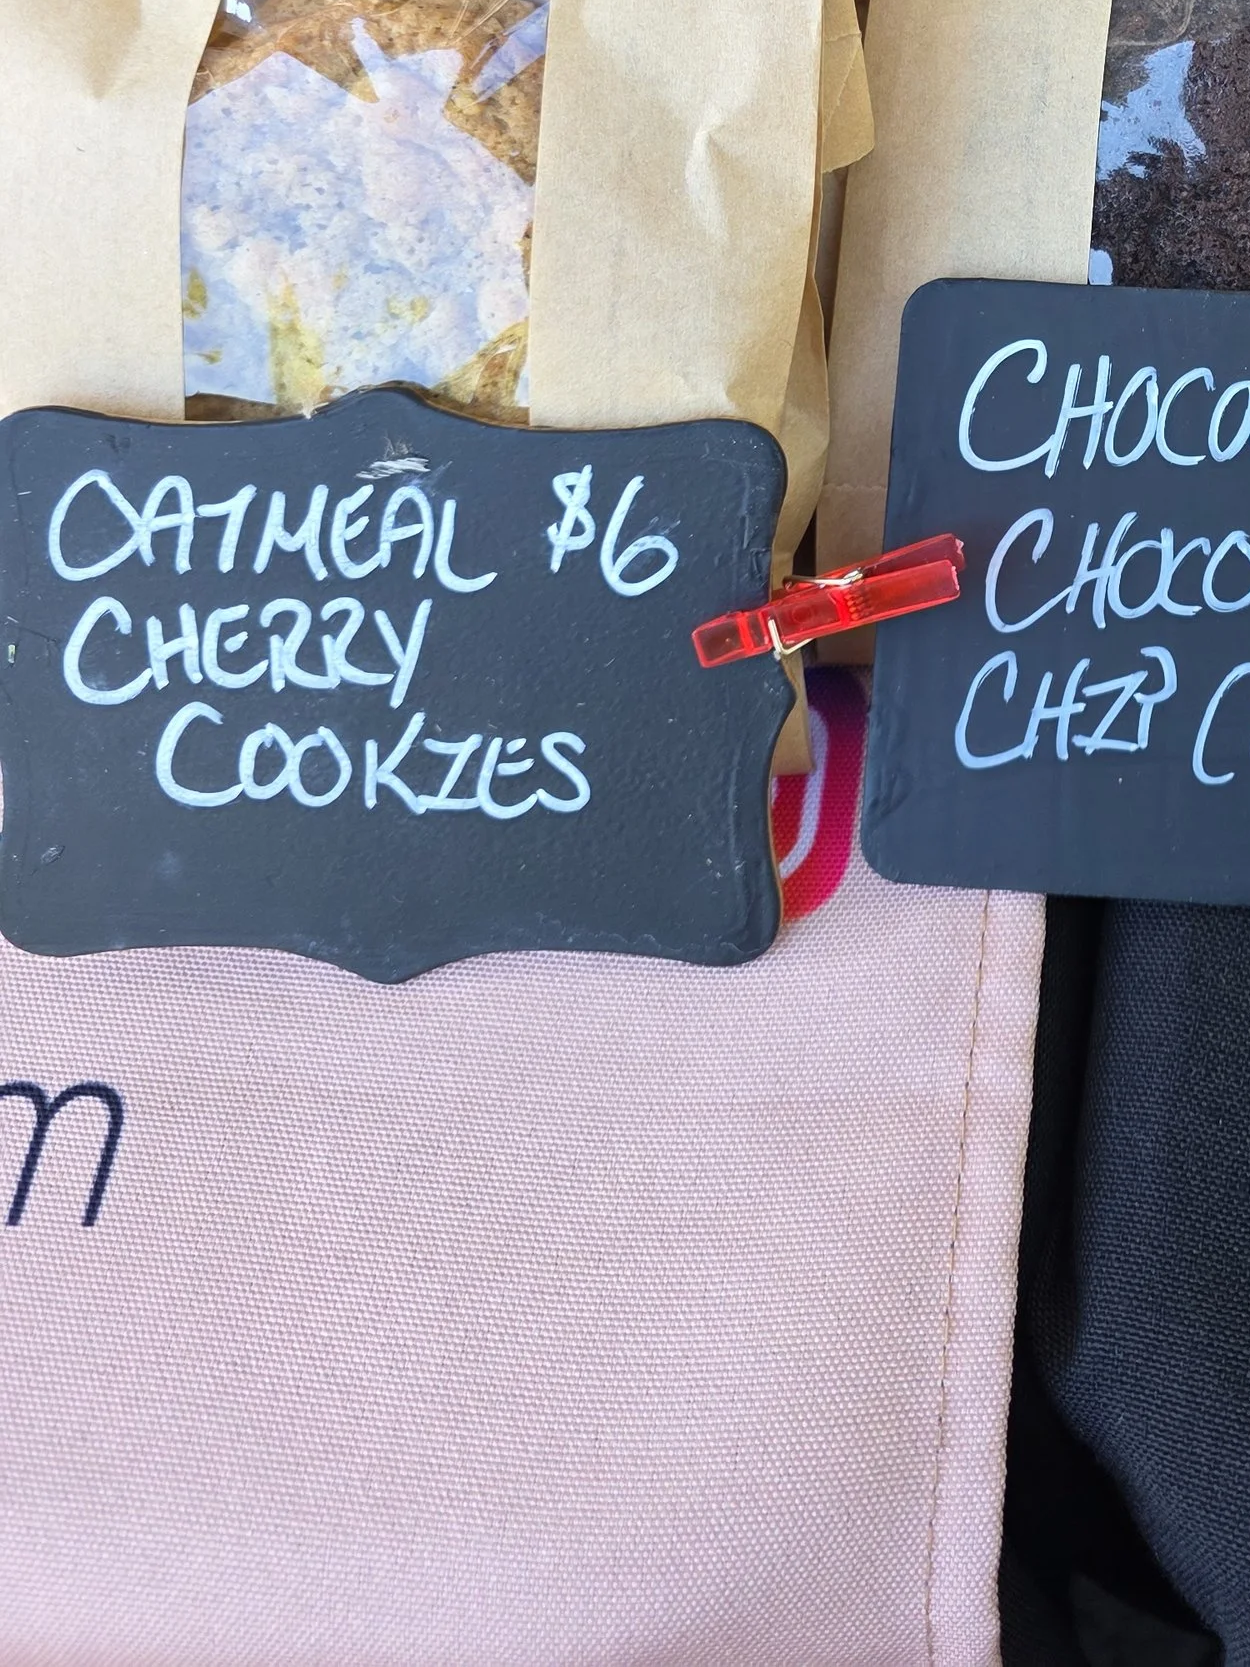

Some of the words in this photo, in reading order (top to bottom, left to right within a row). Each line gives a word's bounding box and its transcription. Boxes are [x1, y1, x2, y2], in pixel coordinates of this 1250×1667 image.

[48, 469, 498, 594] OATMEAL
[547, 464, 681, 597] $6
[63, 596, 434, 708] CHERRY
[955, 646, 1179, 769] CHIP
[155, 702, 592, 820] COOKIES
